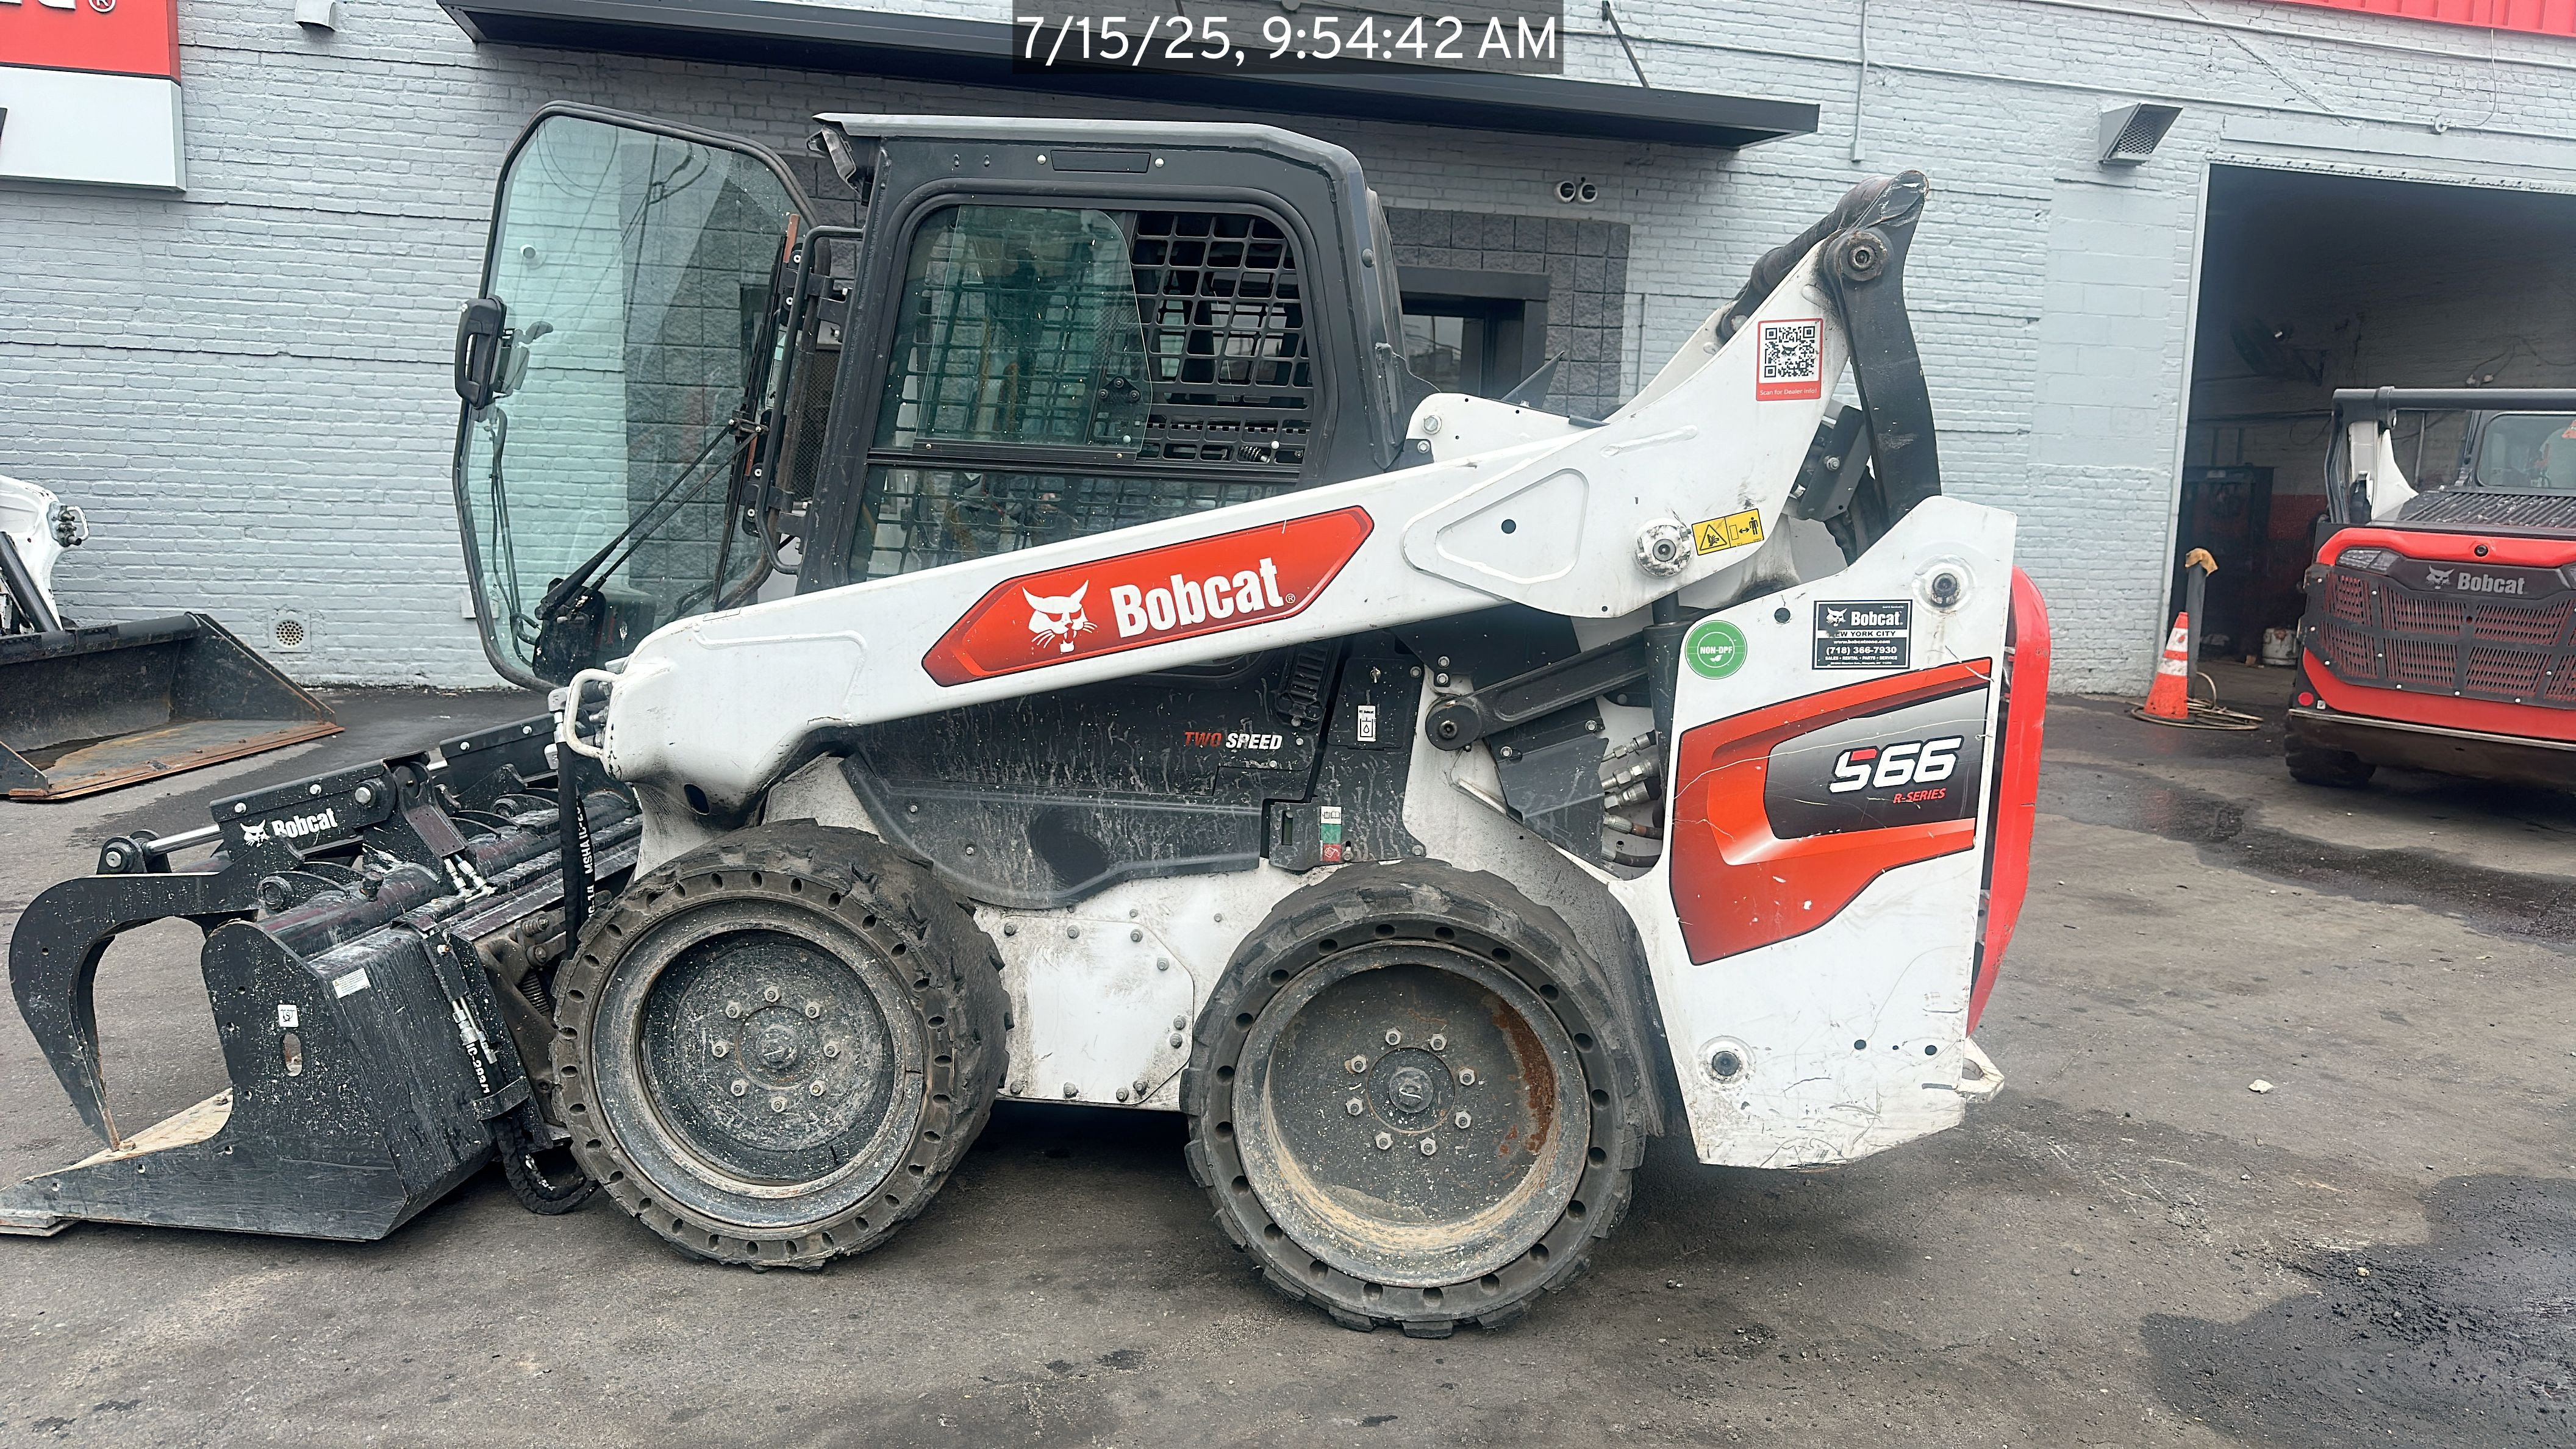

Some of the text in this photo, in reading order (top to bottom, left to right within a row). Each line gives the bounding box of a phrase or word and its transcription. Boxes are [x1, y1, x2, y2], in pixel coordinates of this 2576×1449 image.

[2457, 572, 2525, 595] Bobcat
[1700, 646, 1733, 654] NON-DPF
[1826, 646, 1851, 656] (718)
[1184, 731, 1283, 750] TWO SPEED
[1828, 736, 1963, 793] S66
[1893, 788, 1947, 804] R-SERIES
[579, 839, 594, 875] MSHA
